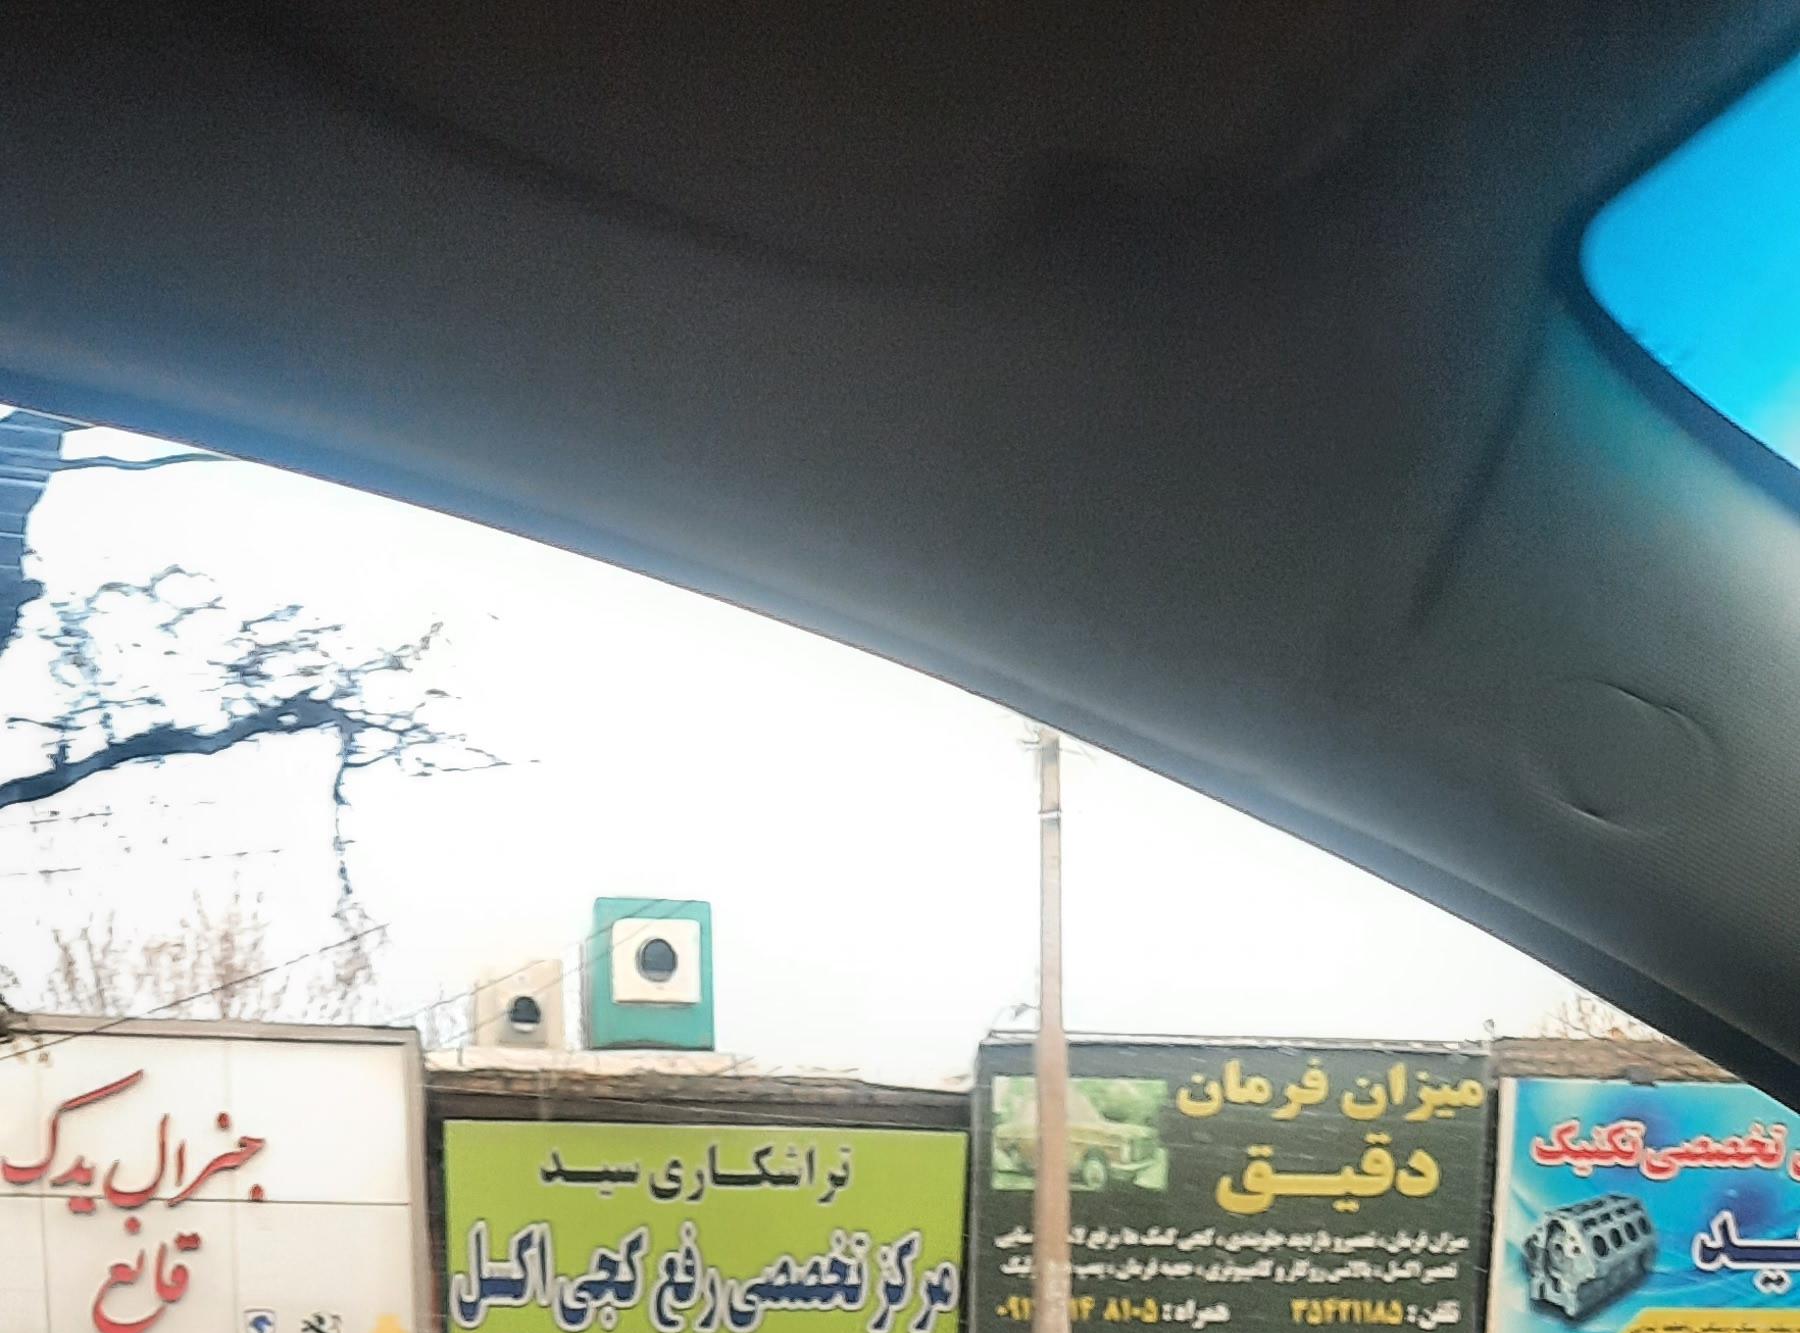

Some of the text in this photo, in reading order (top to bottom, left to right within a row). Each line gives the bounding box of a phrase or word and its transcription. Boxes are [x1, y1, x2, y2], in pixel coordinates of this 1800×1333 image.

[1176, 1056, 1486, 1122] میزان فرمان
[1, 1069, 266, 1214] جنرال یدک
[540, 1143, 852, 1202] تراشکاری سید
[1215, 1130, 1441, 1215] دقیق
[1530, 1118, 1646, 1178] تکنیک
[1639, 1121, 1788, 1180] تخصصی
[454, 1217, 552, 1330] اکسل
[555, 1225, 649, 1333] کجی
[652, 1220, 722, 1333] رفع
[725, 1229, 870, 1333] تخصصی
